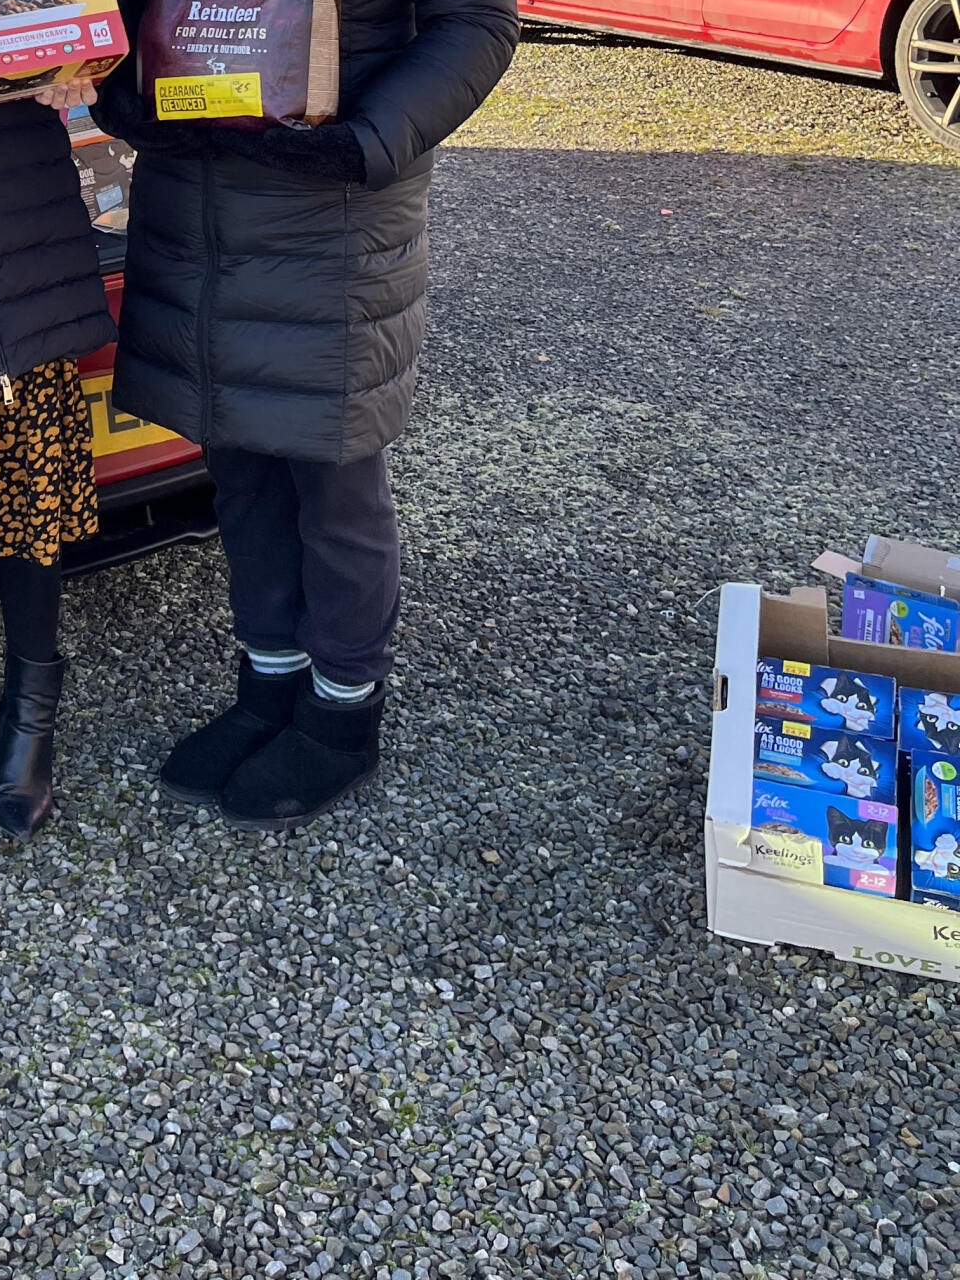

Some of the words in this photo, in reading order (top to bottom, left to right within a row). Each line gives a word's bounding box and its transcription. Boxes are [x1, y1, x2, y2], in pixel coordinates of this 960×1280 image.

[188, 1, 261, 22] Reindeer
[93, 27, 108, 39] 40
[176, 26, 196, 38] FOR
[199, 27, 236, 39] ADULT
[238, 28, 267, 39] CATS
[0, 33, 34, 47] SELECTION
[35, 32, 44, 40] IN
[186, 43, 212, 53] ENERGY
[213, 44, 219, 54] &
[219, 44, 251, 55] OUTDOOR
[159, 85, 205, 98] CLEARANCE
[162, 98, 205, 112] REDUCED
[776, 674, 803, 687] GOOD
[775, 736, 804, 749] GOOD
[754, 793, 790, 808] felix
[867, 804, 889, 817] 2-12
[755, 844, 812, 866] Keelings
[860, 873, 887, 887] 2-12
[852, 945, 942, 974] LOVE
